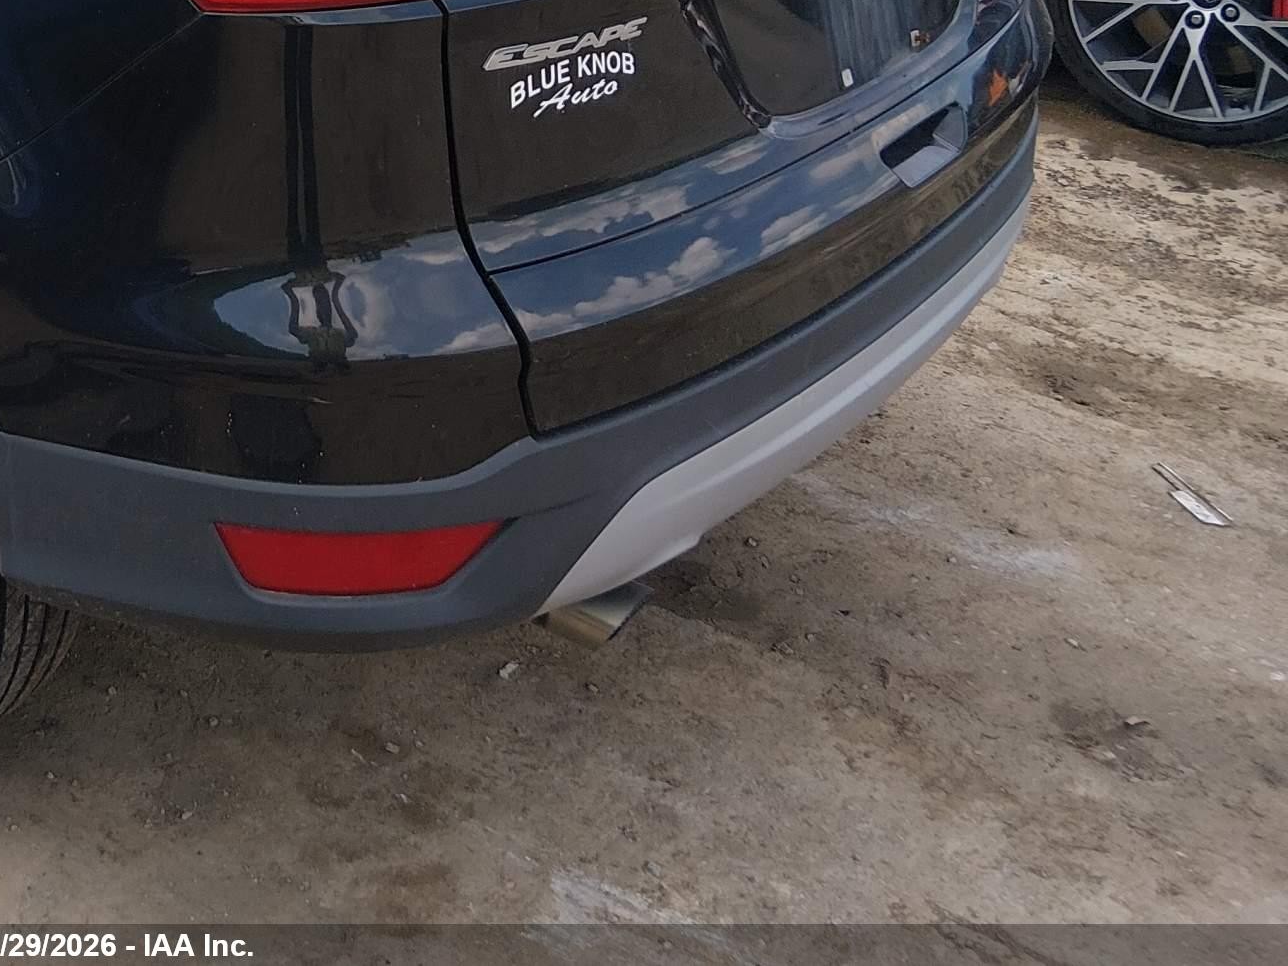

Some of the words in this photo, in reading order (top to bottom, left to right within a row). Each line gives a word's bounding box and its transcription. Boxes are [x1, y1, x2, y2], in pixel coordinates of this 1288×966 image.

[482, 16, 648, 71] ESCAPE
[510, 59, 570, 110] BLUE
[577, 52, 635, 79] KNOB
[533, 78, 619, 118] Auto
